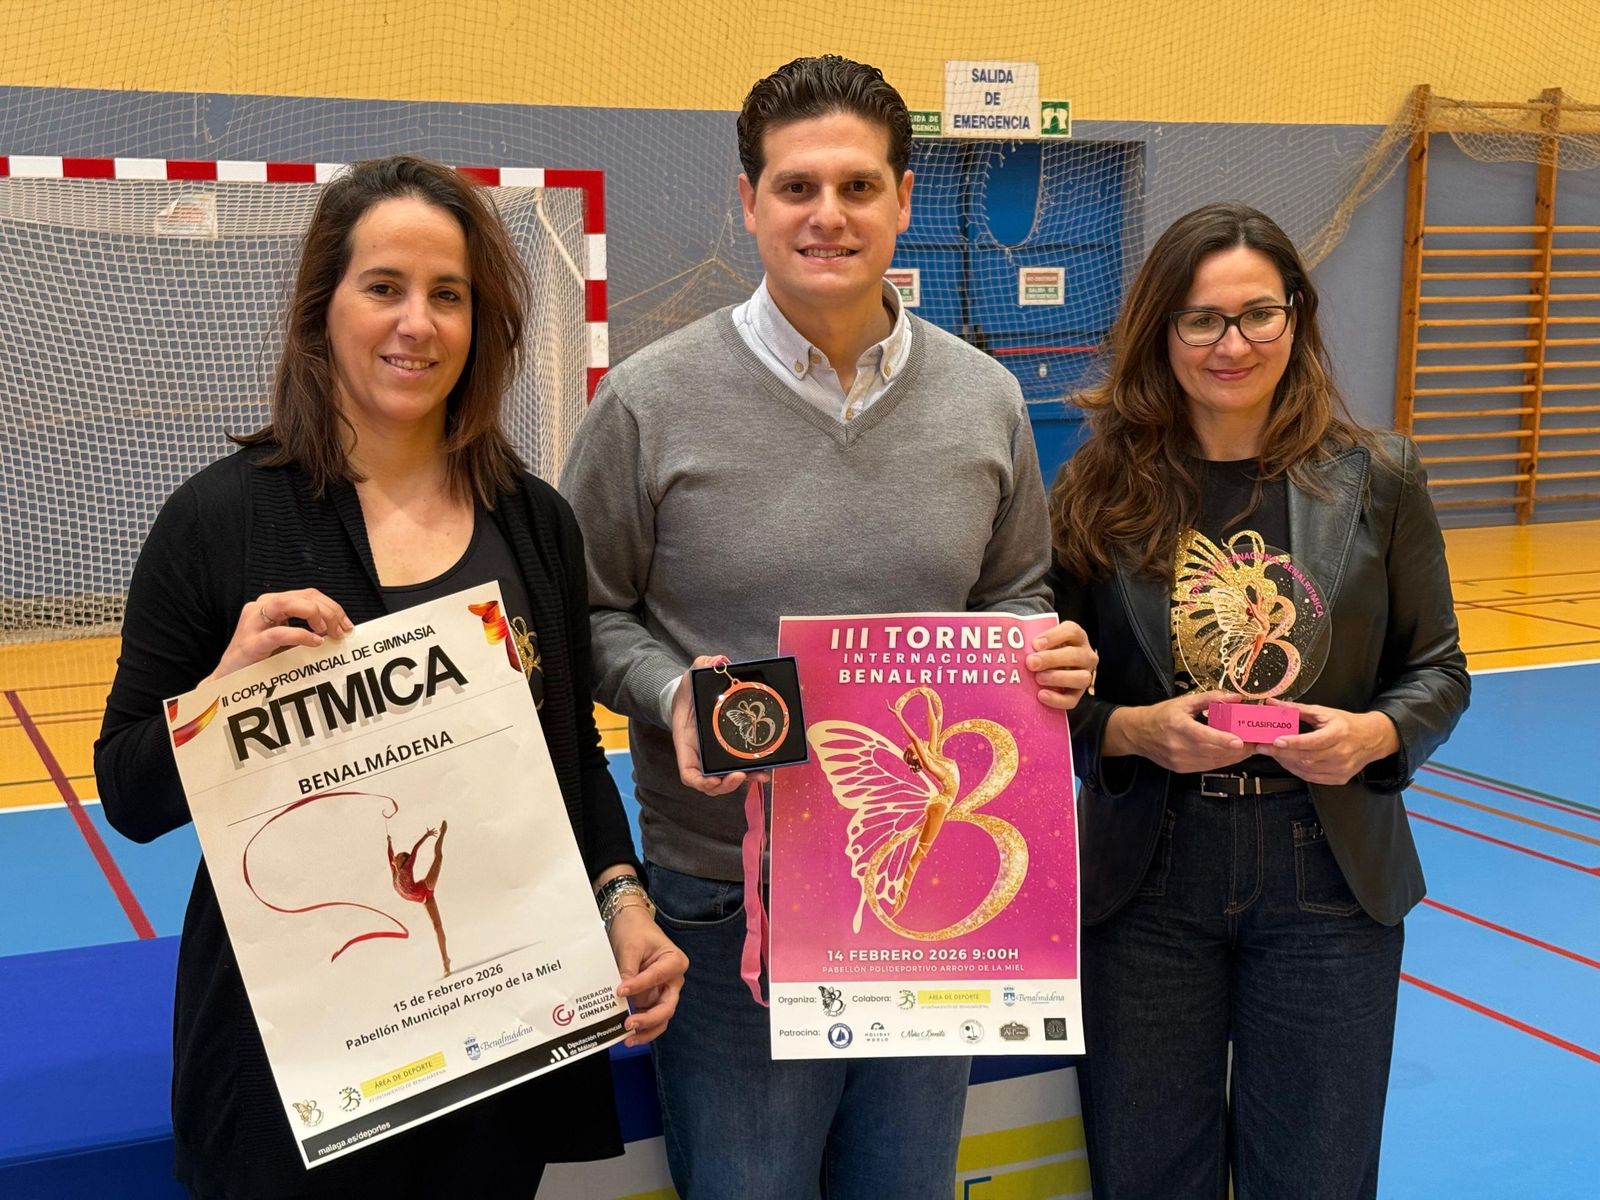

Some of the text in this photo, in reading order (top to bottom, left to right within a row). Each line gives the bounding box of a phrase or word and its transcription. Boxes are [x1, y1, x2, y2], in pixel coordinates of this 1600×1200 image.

[972, 68, 1014, 84] SALIDA
[985, 92, 1000, 106] DE
[954, 114, 1030, 130] EMERGENCIA
[830, 626, 1025, 650] III TORNEO
[222, 625, 435, 708] II COPA PROVINCIAL DE GIMNASIA
[844, 653, 1018, 664] INTERNACIONAL
[839, 666, 1021, 684] BENALRÍTMICA
[227, 645, 469, 762] RÍTMICA
[1247, 720, 1292, 729] CLASIFICADO
[298, 731, 454, 795] BENALMÁDENA
[827, 948, 1019, 962] 14 FEBRERO 2026 9:00H
[822, 965, 867, 973] PABELLÓN
[869, 965, 937, 973] POLIDEPORTIVO
[940, 964, 975, 972] ARROYO
[393, 964, 504, 1014] 15 de Febrero 2026
[576, 986, 612, 1004] FEDERACIÓN
[346, 960, 562, 1050] Pabellón Municipal Arroyo de la Miel
[578, 994, 615, 1012] ANDALUZA
[778, 996, 816, 1005] Organiza:
[580, 1001, 617, 1019] GIMNASIA
[480, 1024, 533, 1050] Benalmádena
[567, 1023, 622, 1050] Diputación Provincial
[780, 1029, 820, 1037] Patrocina:
[374, 1078, 392, 1089] ÁREA
[403, 1061, 432, 1077] DEPORTE
[318, 1121, 391, 1156] malaga.es/deportes
